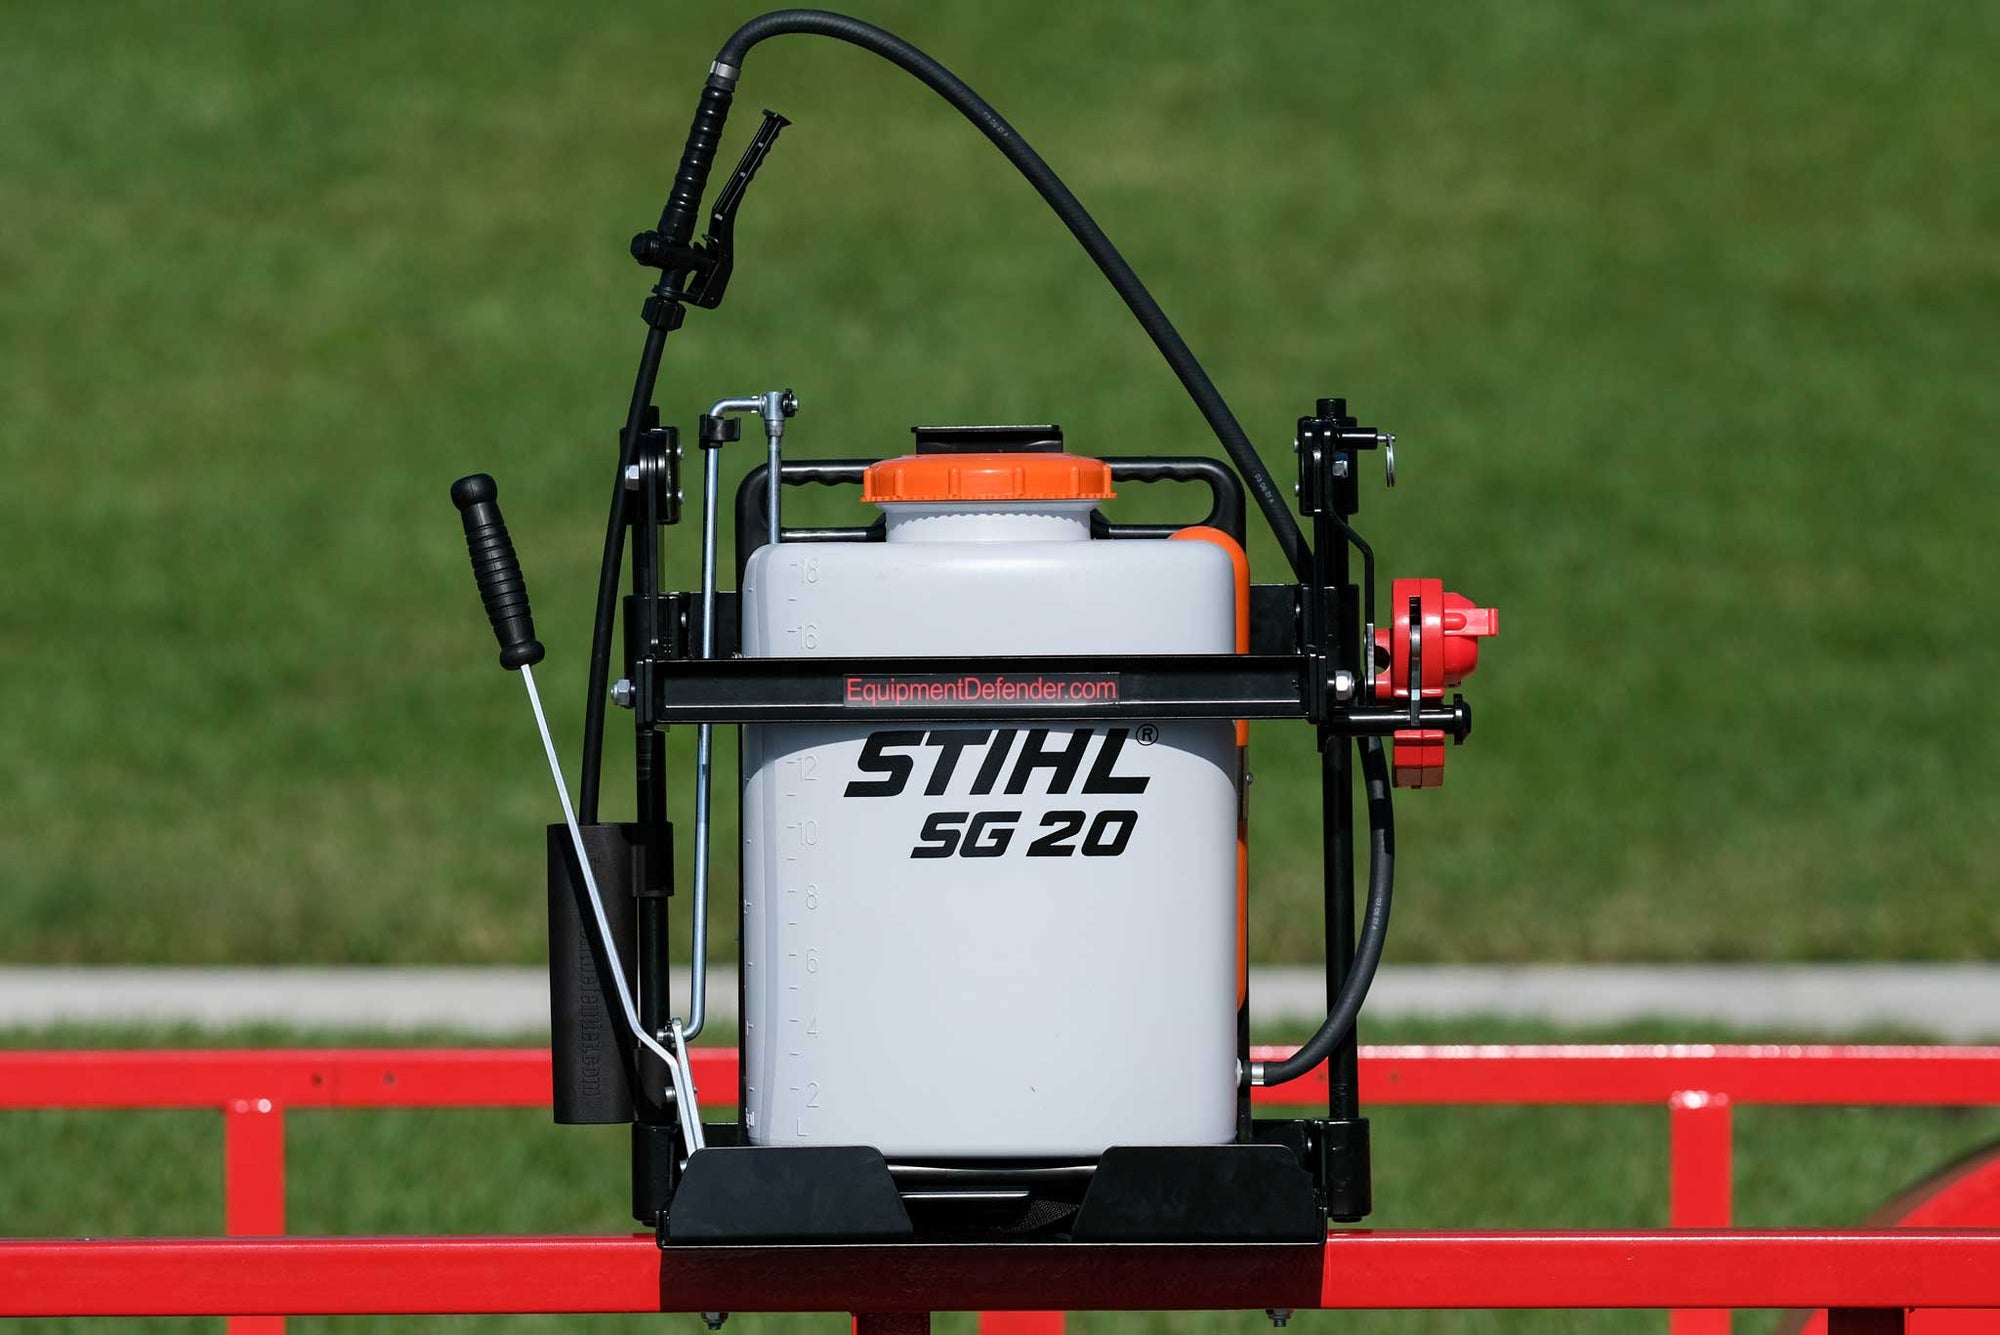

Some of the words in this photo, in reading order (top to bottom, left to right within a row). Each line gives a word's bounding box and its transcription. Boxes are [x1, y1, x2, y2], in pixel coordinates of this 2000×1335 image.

[798, 624, 818, 650] 16
[846, 676, 1118, 706] EquipmentDefender.com
[798, 755, 819, 782] 12
[843, 728, 1151, 798] STIHL
[798, 820, 817, 846] 10
[910, 810, 1023, 859] SG
[1025, 809, 1139, 857] 20
[805, 884, 818, 910] 8
[806, 948, 818, 974] 6
[806, 1082, 820, 1108] 2
